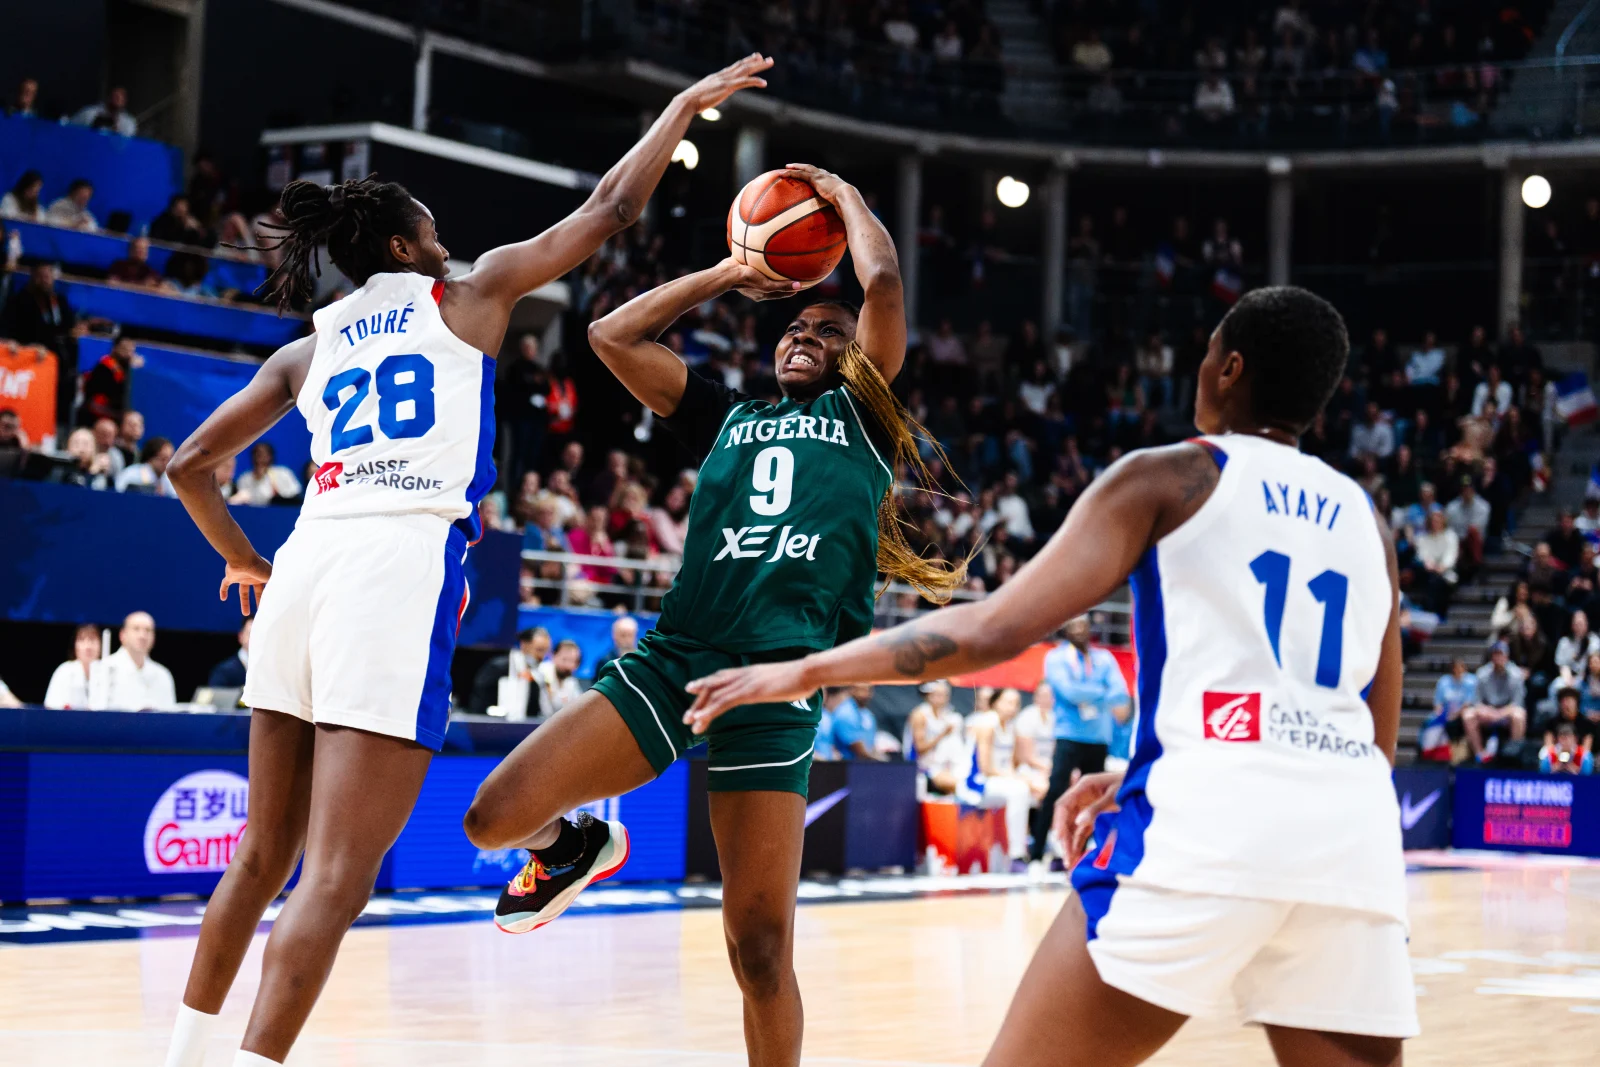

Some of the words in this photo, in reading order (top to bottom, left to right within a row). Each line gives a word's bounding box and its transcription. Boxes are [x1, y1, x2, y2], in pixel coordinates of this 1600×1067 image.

[340, 302, 415, 346] TOURÉ
[322, 353, 436, 456] 28
[724, 415, 849, 449] NIGERIA
[749, 446, 795, 517] 9
[1262, 479, 1341, 532] AYAYI
[766, 525, 822, 563] Jet
[1248, 549, 1349, 690] 11
[1268, 702, 1337, 732] CAIS
[155, 822, 249, 867] Gant
